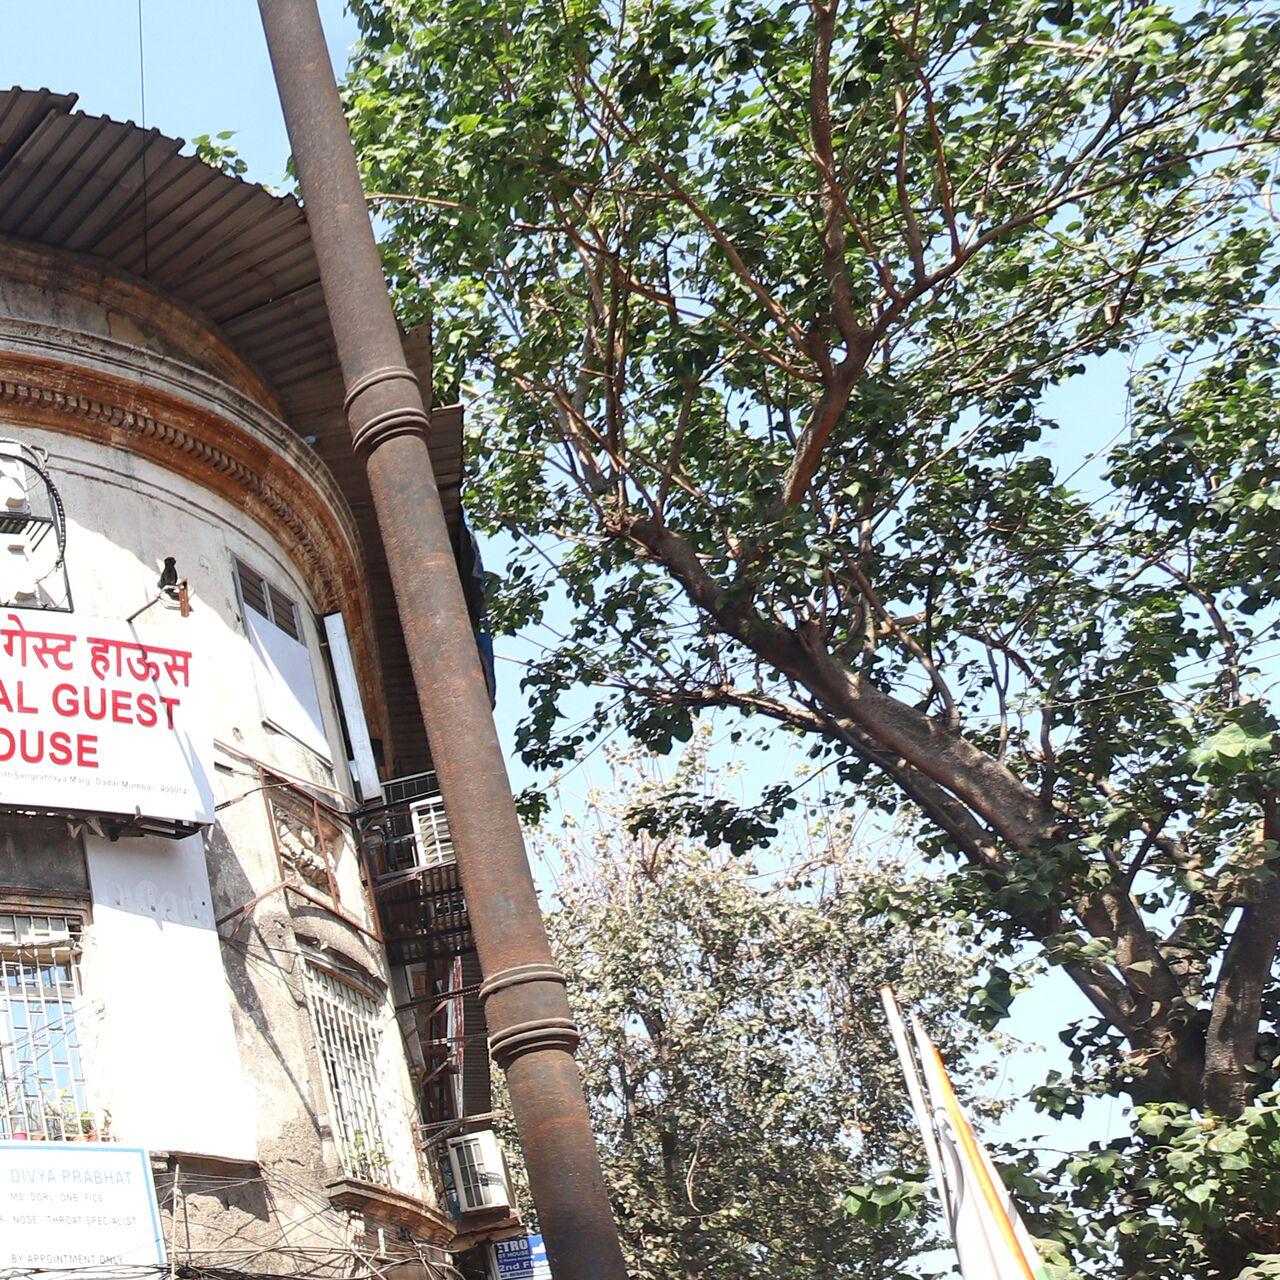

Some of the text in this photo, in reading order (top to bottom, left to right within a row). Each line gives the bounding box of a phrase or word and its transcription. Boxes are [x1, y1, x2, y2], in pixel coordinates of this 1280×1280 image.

[1, 614, 76, 670] गेस्ट
[87, 636, 192, 688] हाऊस
[52, 684, 181, 730] GUEST
[10, 1168, 57, 1184] DIVYA
[62, 1168, 132, 1185] PRABHAT
[47, 1215, 82, 1225] THROAT
[85, 1215, 137, 1226] SPECIALIST
[496, 1239, 529, 1254] ETRO
[10, 1253, 124, 1266] BY APPOINTMENT ONLY
[499, 1262, 520, 1272] 2nd
[523, 1260, 550, 1269] Floo
